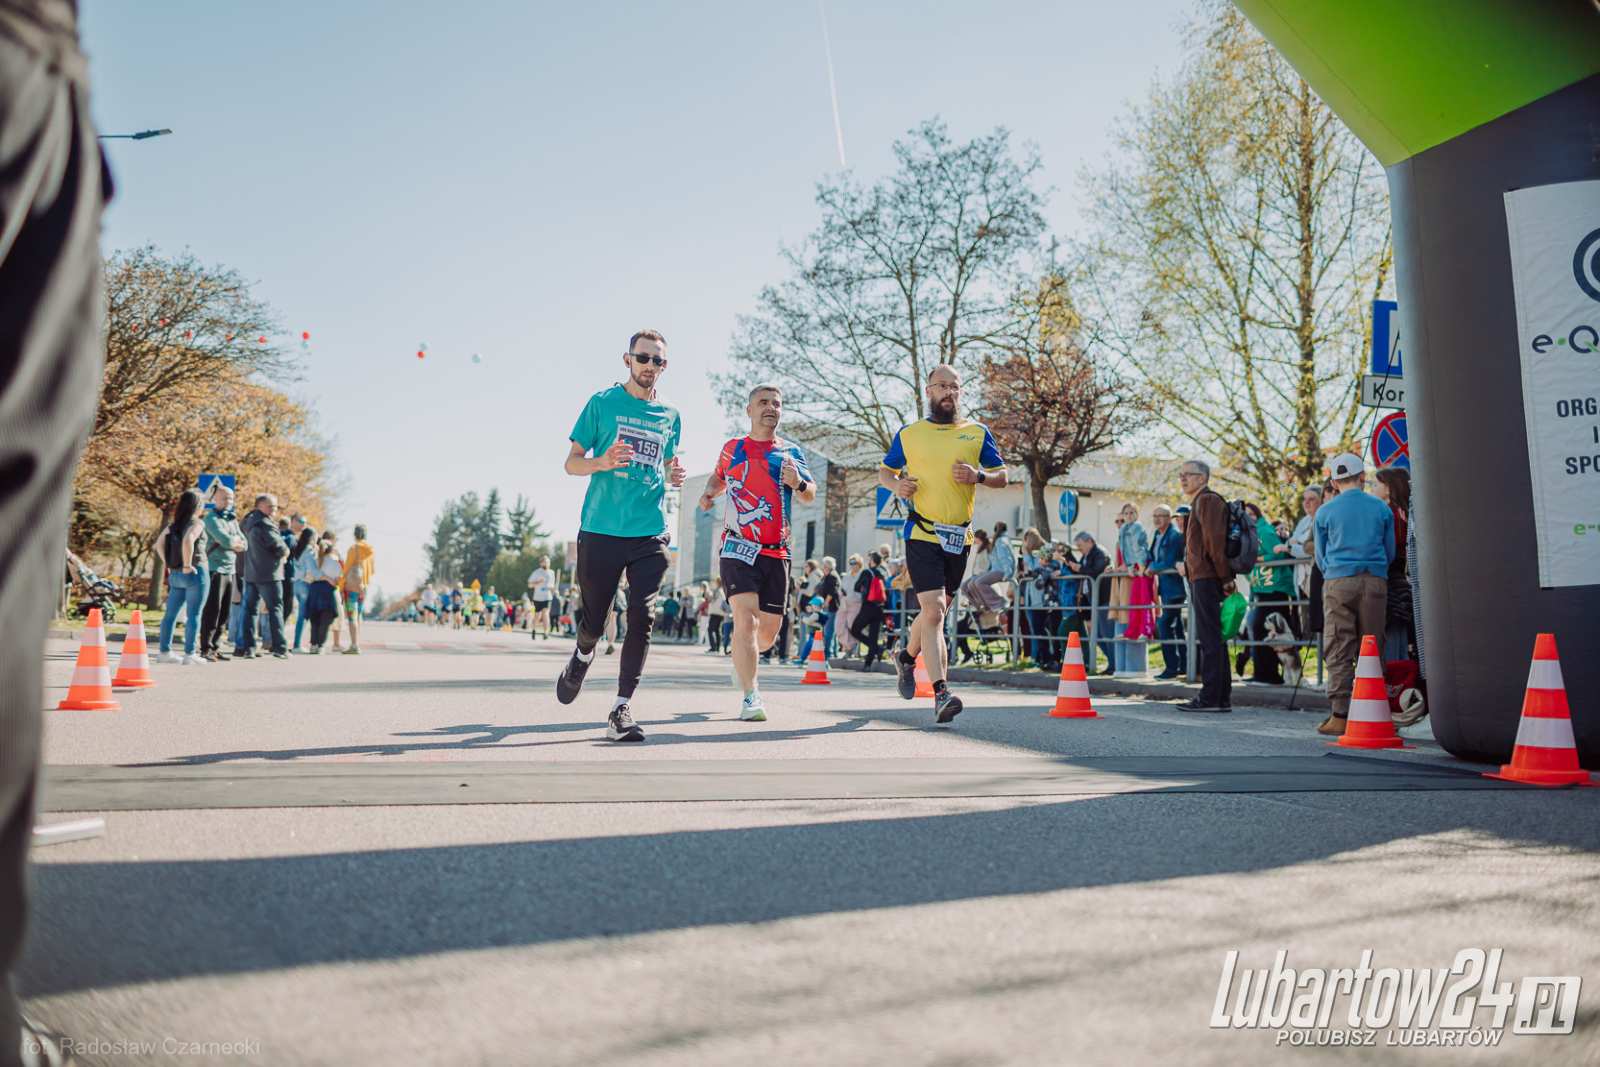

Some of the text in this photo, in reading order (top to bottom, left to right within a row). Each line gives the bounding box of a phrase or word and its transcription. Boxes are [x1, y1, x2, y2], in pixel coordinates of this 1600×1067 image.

[1556, 397, 1600, 418] ORG
[637, 440, 658, 457] 155
[736, 543, 754, 557] 012
